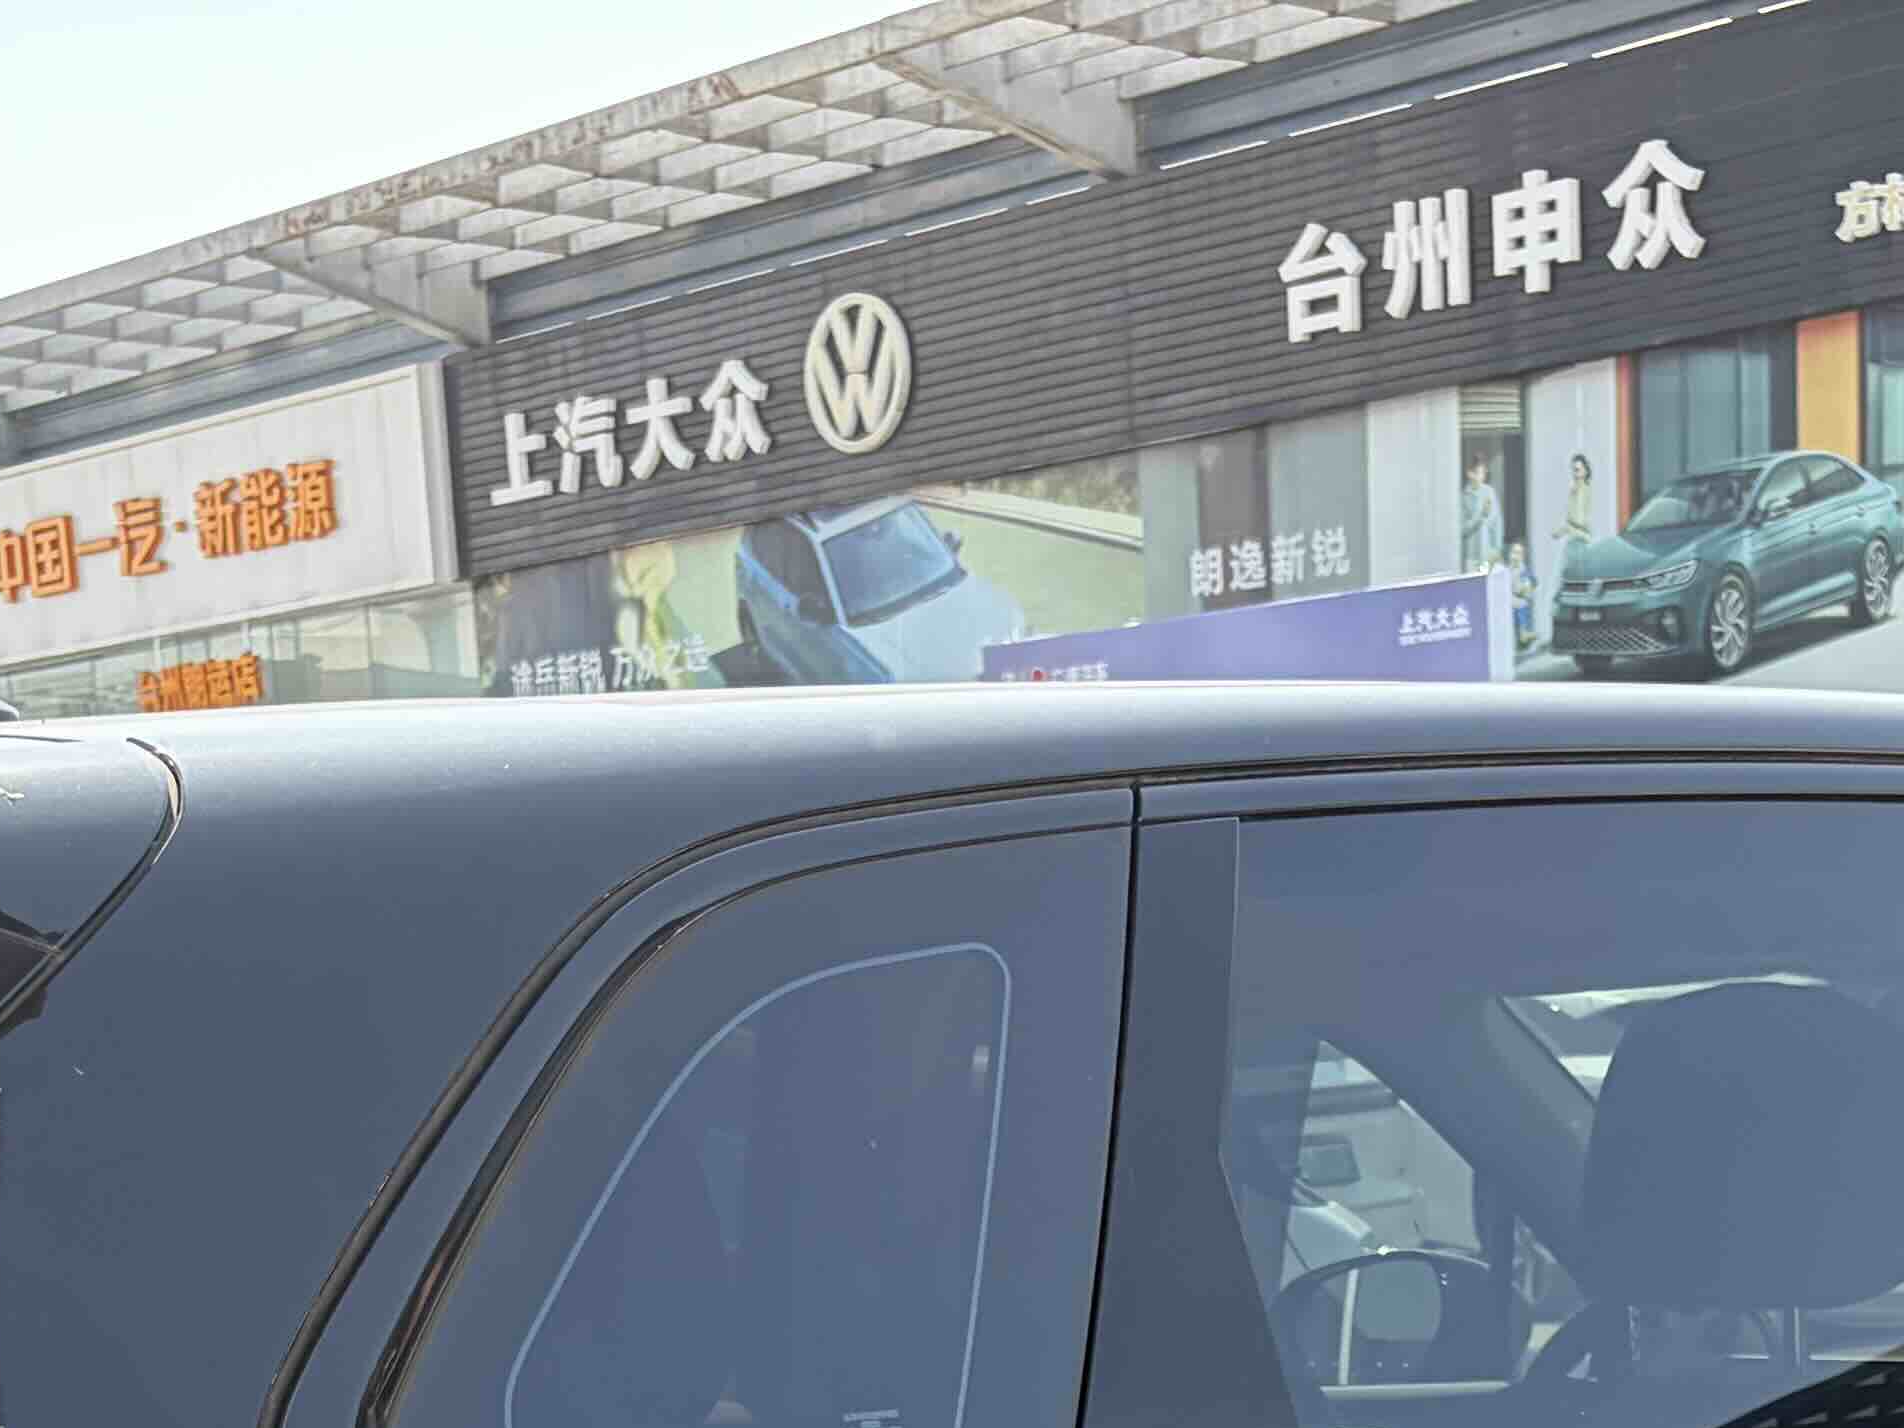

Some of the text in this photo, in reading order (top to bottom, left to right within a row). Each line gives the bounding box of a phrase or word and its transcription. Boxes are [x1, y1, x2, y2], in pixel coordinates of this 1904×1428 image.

[1278, 139, 1707, 343] 台州申众
[489, 359, 773, 507] 上汽大众
[1188, 525, 1352, 600] 朗逸新锐
